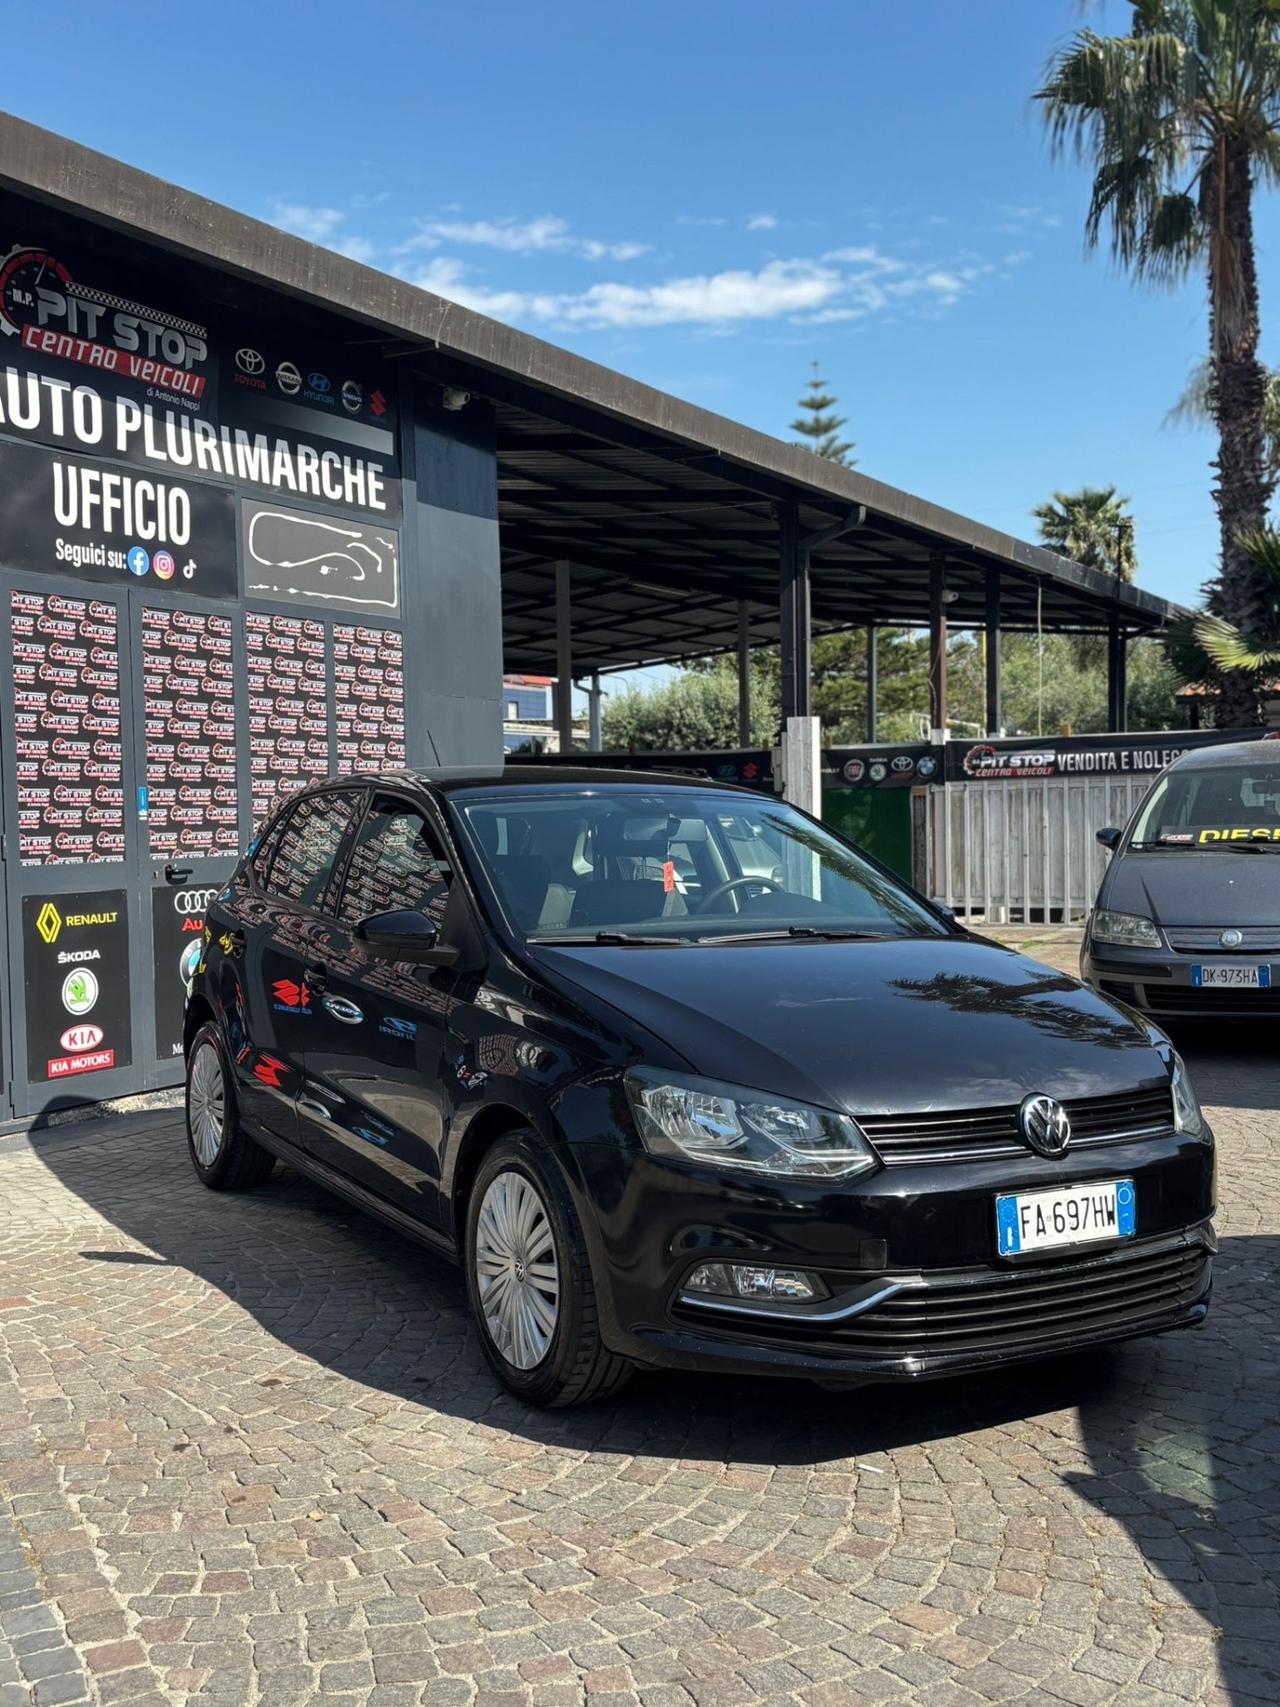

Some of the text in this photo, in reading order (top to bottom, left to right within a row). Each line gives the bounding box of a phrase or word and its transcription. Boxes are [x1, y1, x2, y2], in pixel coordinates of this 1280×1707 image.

[13, 288, 34, 307] M.P.
[35, 286, 208, 370] PIT STOP
[25, 327, 200, 394] CENTRO VEICOLI
[234, 374, 267, 390] TOYOTA
[146, 388, 200, 411] di Antonio Nappi
[0, 366, 386, 510] UTO PLURIMARCHE
[53, 462, 190, 546] UFFICIO
[55, 538, 127, 569] Seguici su:
[981, 756, 1008, 768] PIT
[1009, 754, 1055, 767] STOP
[1057, 752, 1117, 771] VENDITA
[1121, 751, 1129, 770] E
[66, 912, 118, 927] RENAULT
[182, 918, 203, 932] Au
[57, 949, 101, 964] ŠKODA
[68, 1033, 97, 1046] KIA
[51, 1052, 111, 1073] KIA MOTORS
